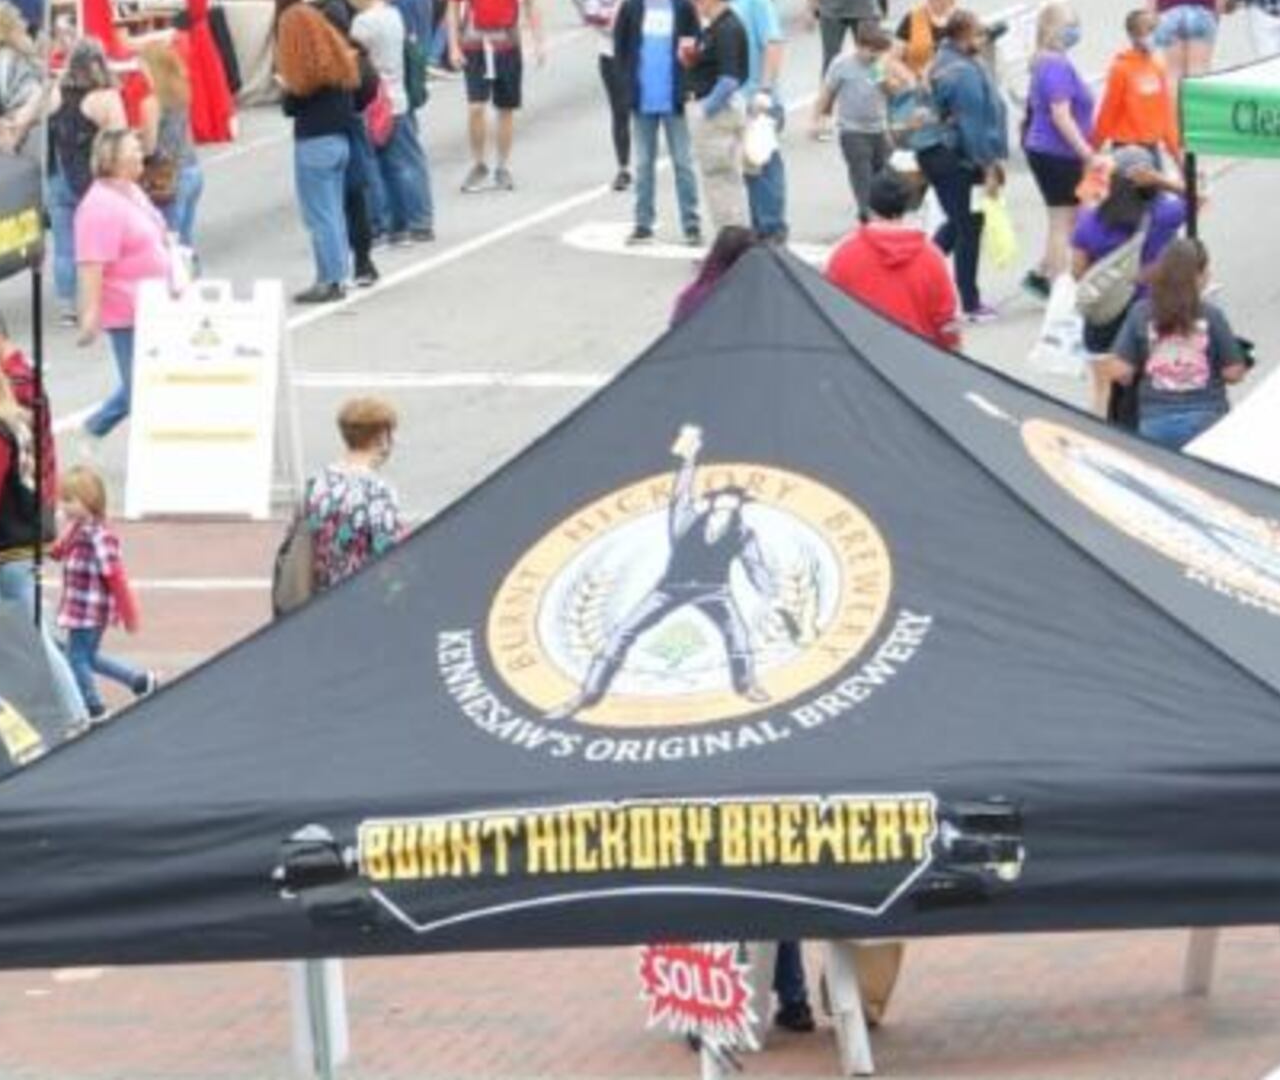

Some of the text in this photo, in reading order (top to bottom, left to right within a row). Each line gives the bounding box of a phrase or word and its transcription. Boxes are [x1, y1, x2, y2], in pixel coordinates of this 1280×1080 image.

[436, 607, 934, 762] KENNESAW'S ORIGINAL BREWERY
[363, 798, 934, 880] BURNT HICKORY BREWERY
[648, 953, 734, 1008] SOLD
